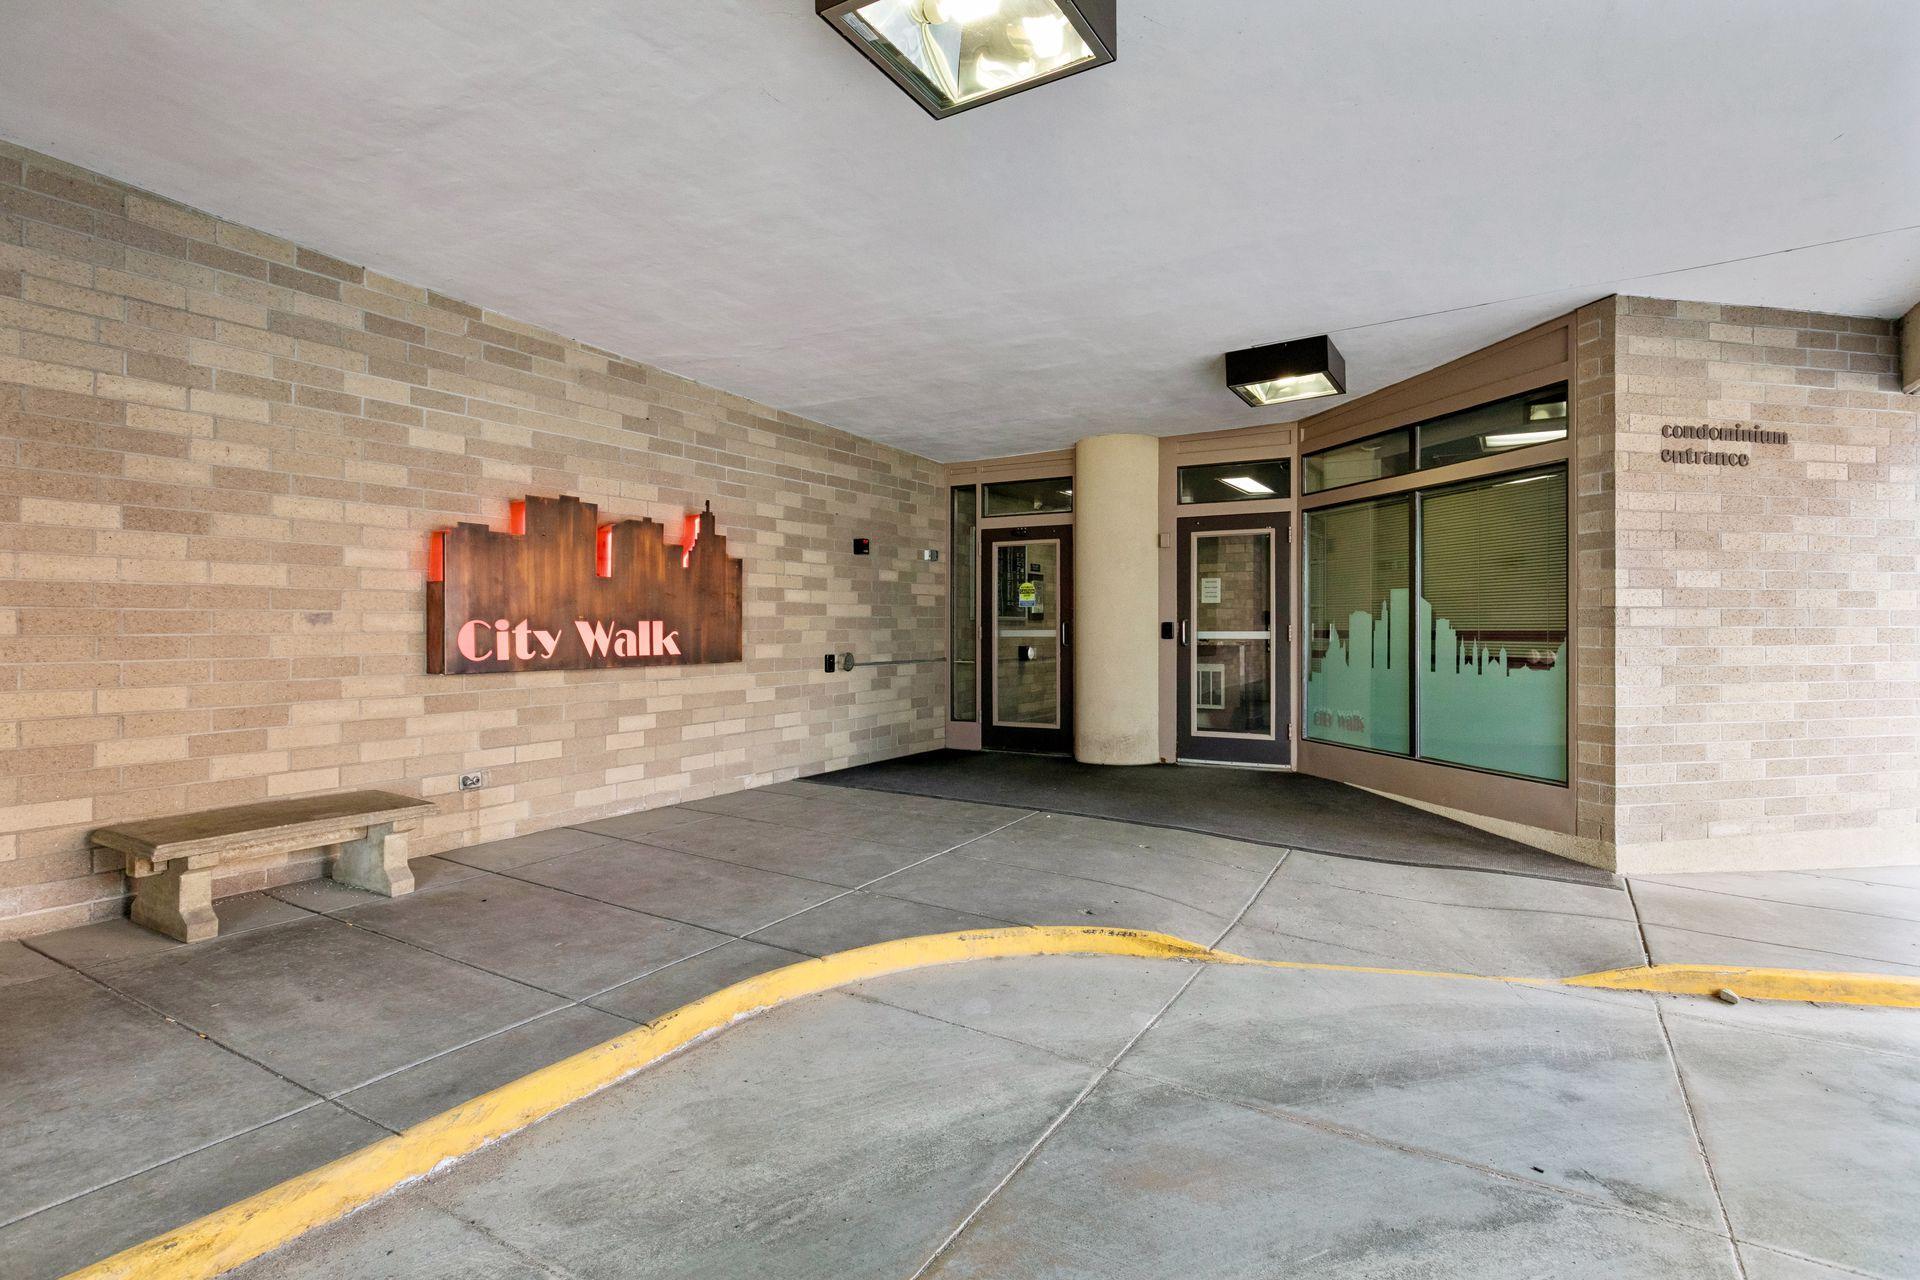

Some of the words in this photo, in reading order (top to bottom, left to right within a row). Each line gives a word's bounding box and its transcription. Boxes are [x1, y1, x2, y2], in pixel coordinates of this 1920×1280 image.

[1661, 423, 1788, 444] condominium
[1660, 447, 1749, 466] entrance
[457, 618, 561, 661] City
[574, 619, 681, 658] Walk
